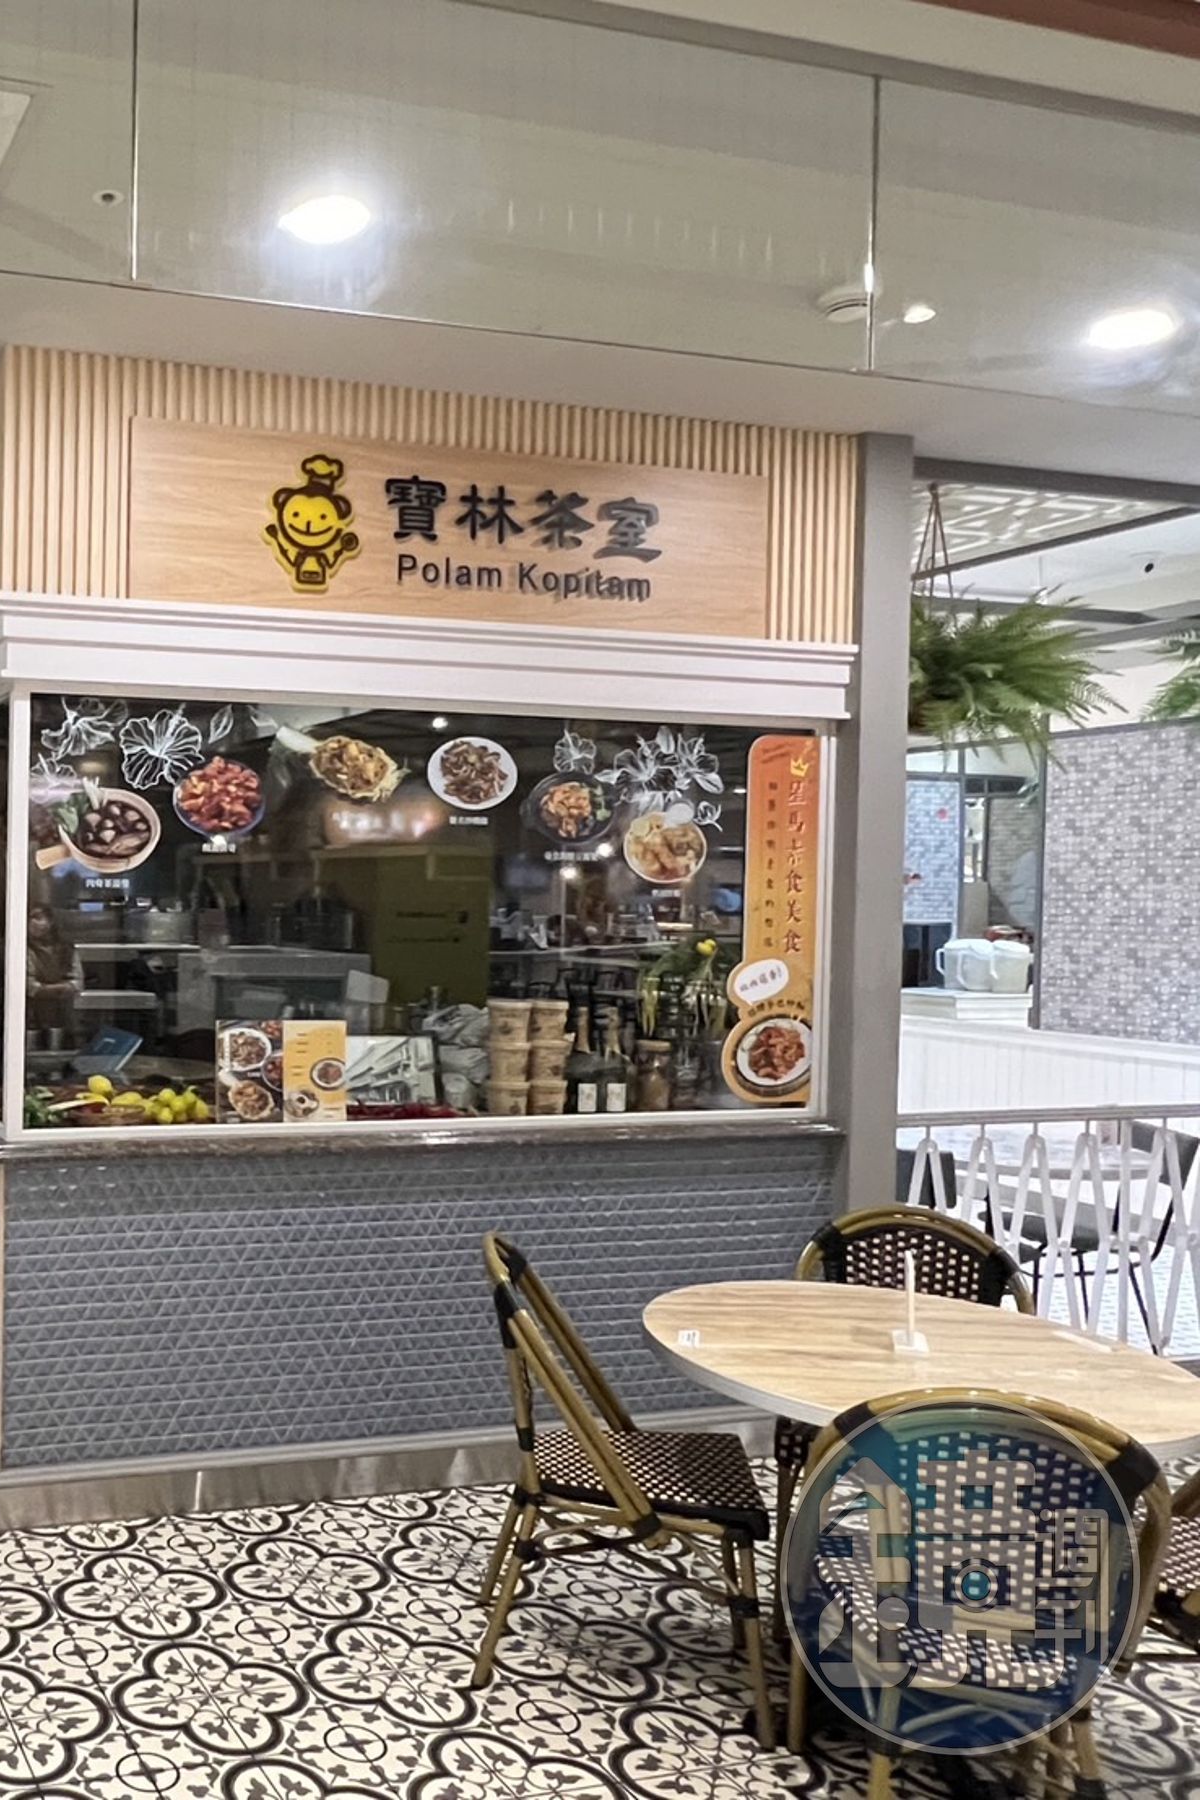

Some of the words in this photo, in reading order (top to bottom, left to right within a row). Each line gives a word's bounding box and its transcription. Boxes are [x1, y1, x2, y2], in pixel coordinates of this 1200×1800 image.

[385, 475, 663, 563] 寶林茶室
[397, 553, 503, 588] Polam
